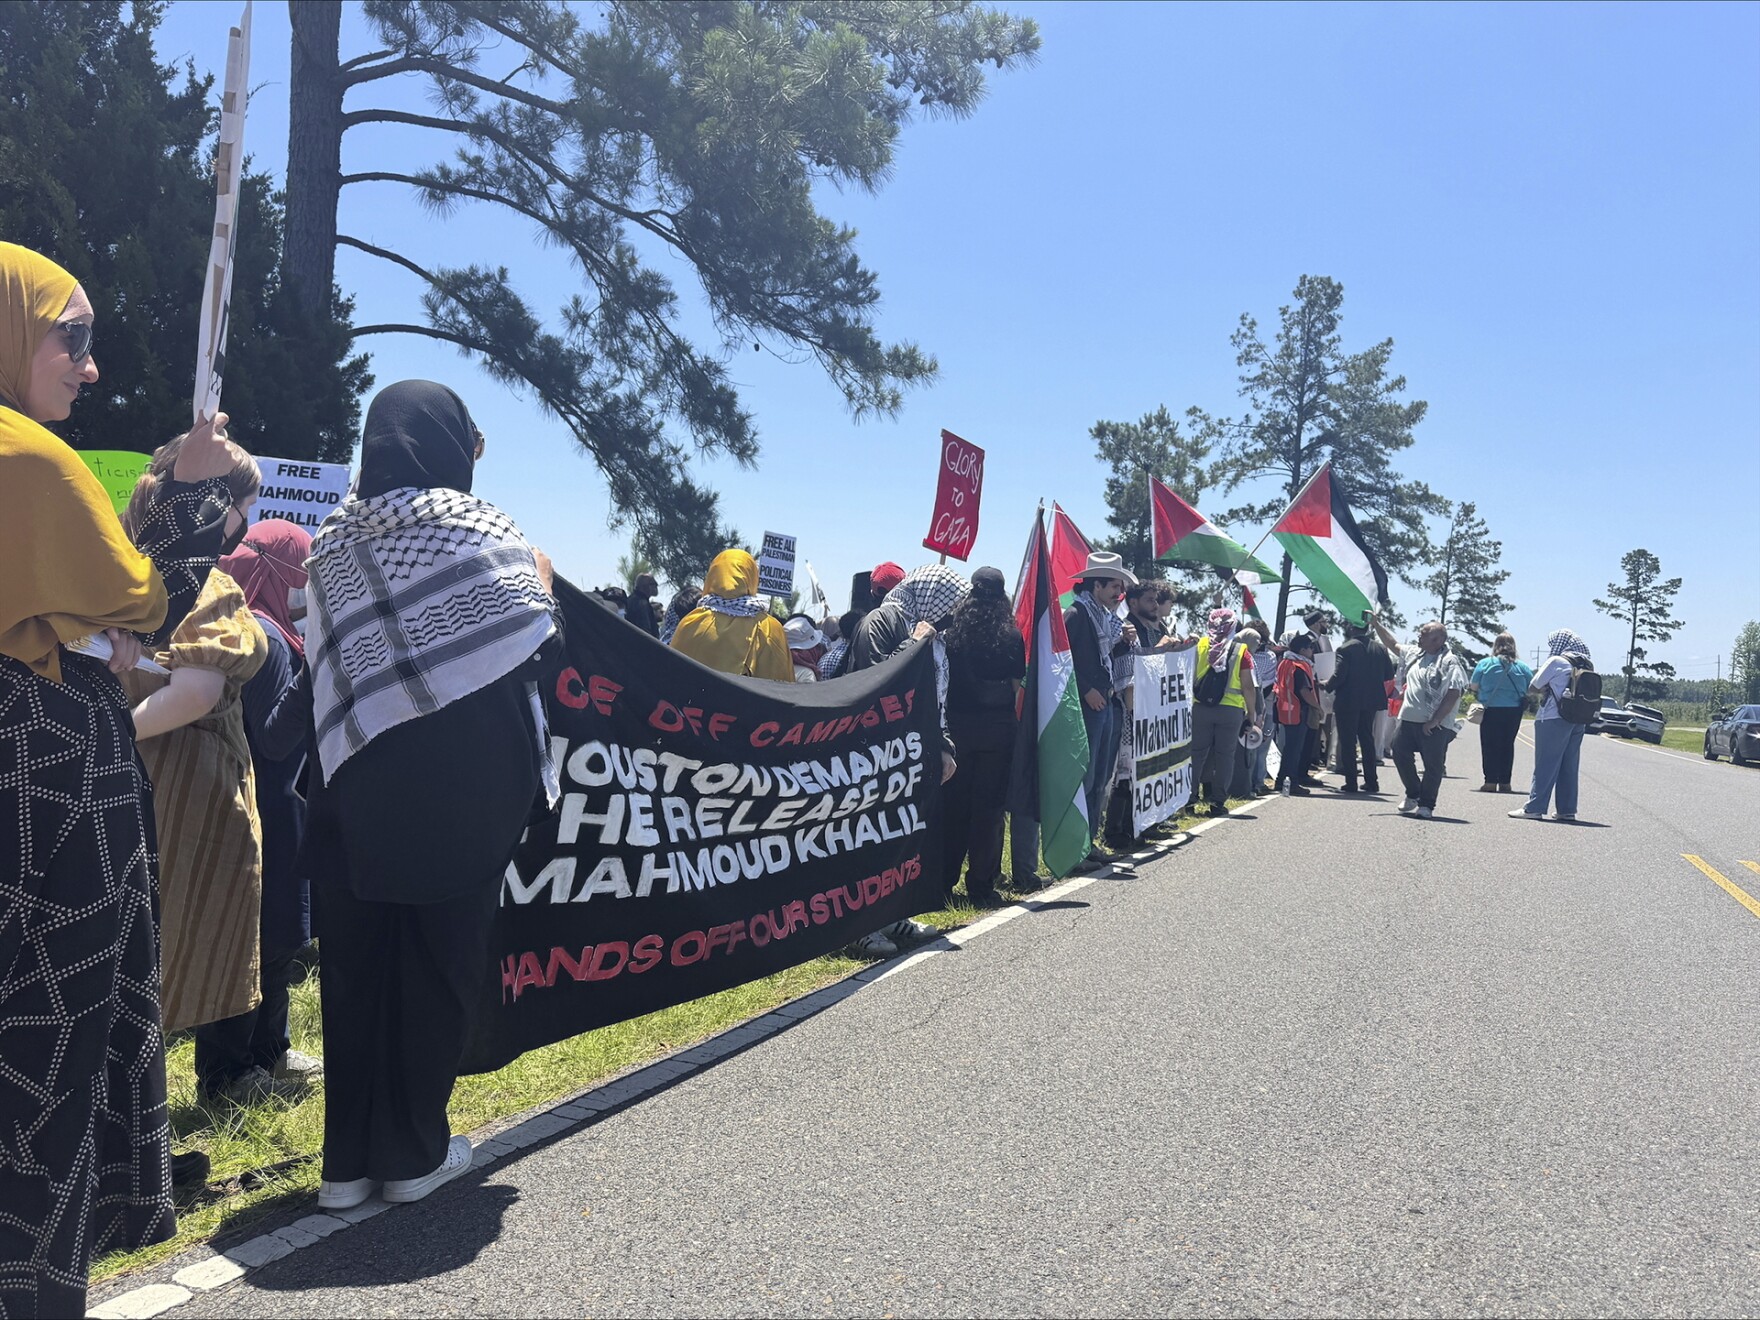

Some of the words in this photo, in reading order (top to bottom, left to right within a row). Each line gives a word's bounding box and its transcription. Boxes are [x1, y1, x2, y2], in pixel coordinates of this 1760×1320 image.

[94, 457, 143, 477] ticis
[277, 464, 321, 480] FREE
[945, 441, 981, 494] GLORY
[951, 487, 964, 507] TO
[259, 509, 321, 527] KHALIL
[763, 535, 783, 549] FREE
[783, 539, 795, 553] ALL
[934, 512, 970, 558] GAZA
[761, 548, 795, 562] PALESTINIAN
[758, 577, 792, 592] PRISONERS
[759, 565, 792, 581] POLITICAL
[1161, 674, 1186, 706] FEE
[649, 700, 737, 741] OFF
[771, 732, 923, 798] DEMANDS
[520, 792, 660, 847] HE
[661, 779, 879, 843] RELEASE
[883, 763, 923, 802] OF
[500, 835, 791, 907] MAHMOUD
[794, 803, 927, 864] KHALIL
[501, 935, 664, 1005] HANDS
[670, 919, 746, 966] OFF
[750, 900, 809, 947] OUR
[810, 854, 921, 925] STUDENTS
